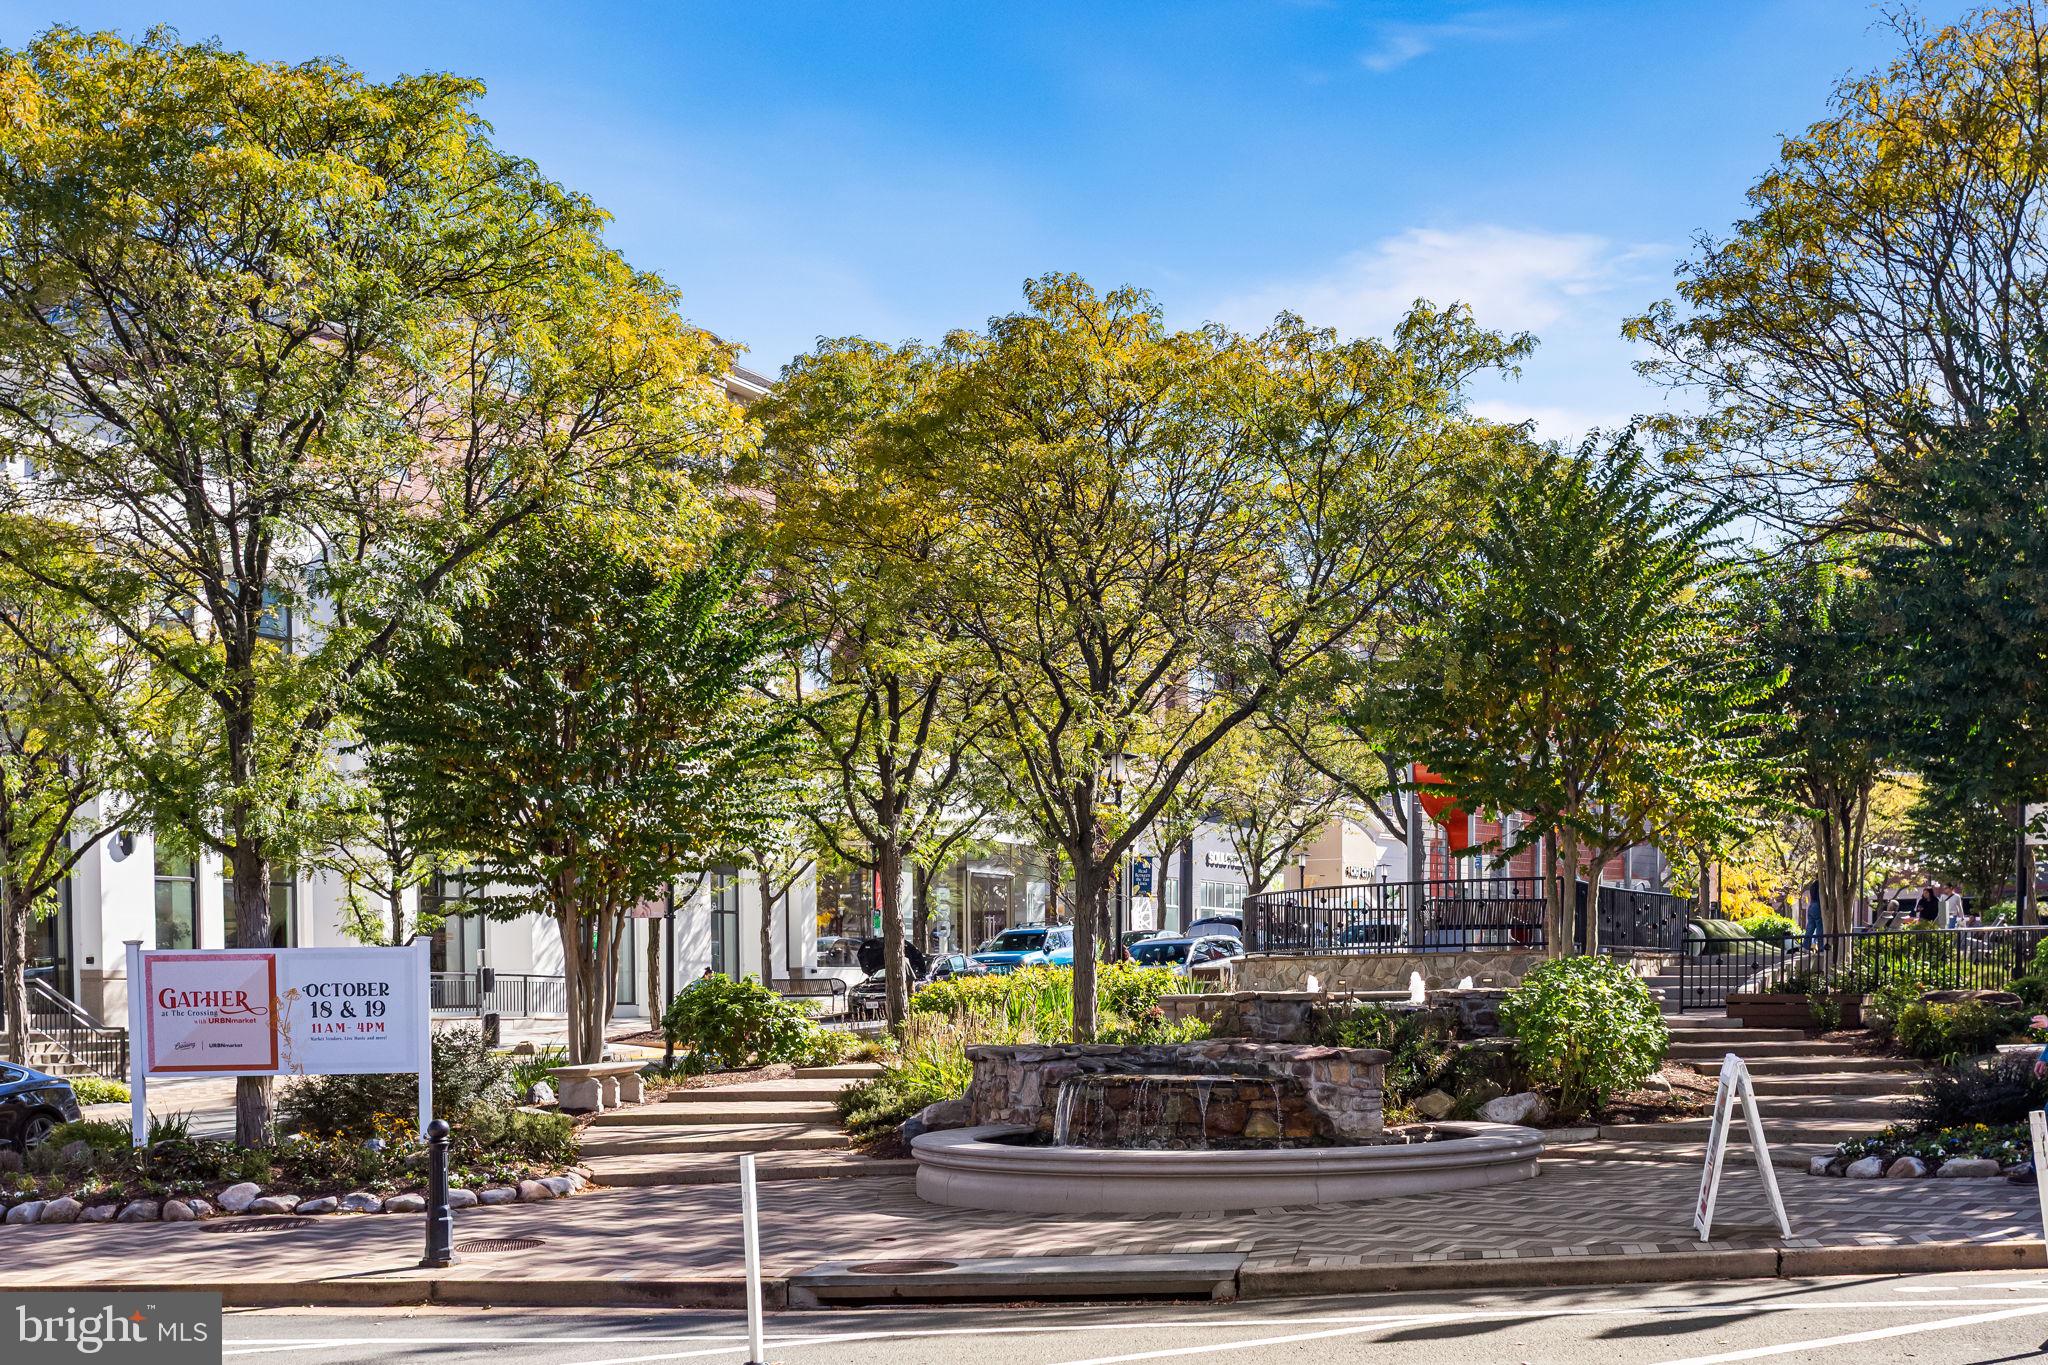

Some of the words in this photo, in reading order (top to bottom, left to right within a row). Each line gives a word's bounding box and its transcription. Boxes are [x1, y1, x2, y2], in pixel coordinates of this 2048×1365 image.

[302, 983, 389, 997] OCTOBER
[158, 988, 268, 1015] GATHER
[310, 1000, 333, 1018] 18
[340, 1000, 357, 1018] &
[364, 999, 386, 1017] 19
[187, 1009, 218, 1017] Crossing
[356, 1021, 385, 1033] 4PM
